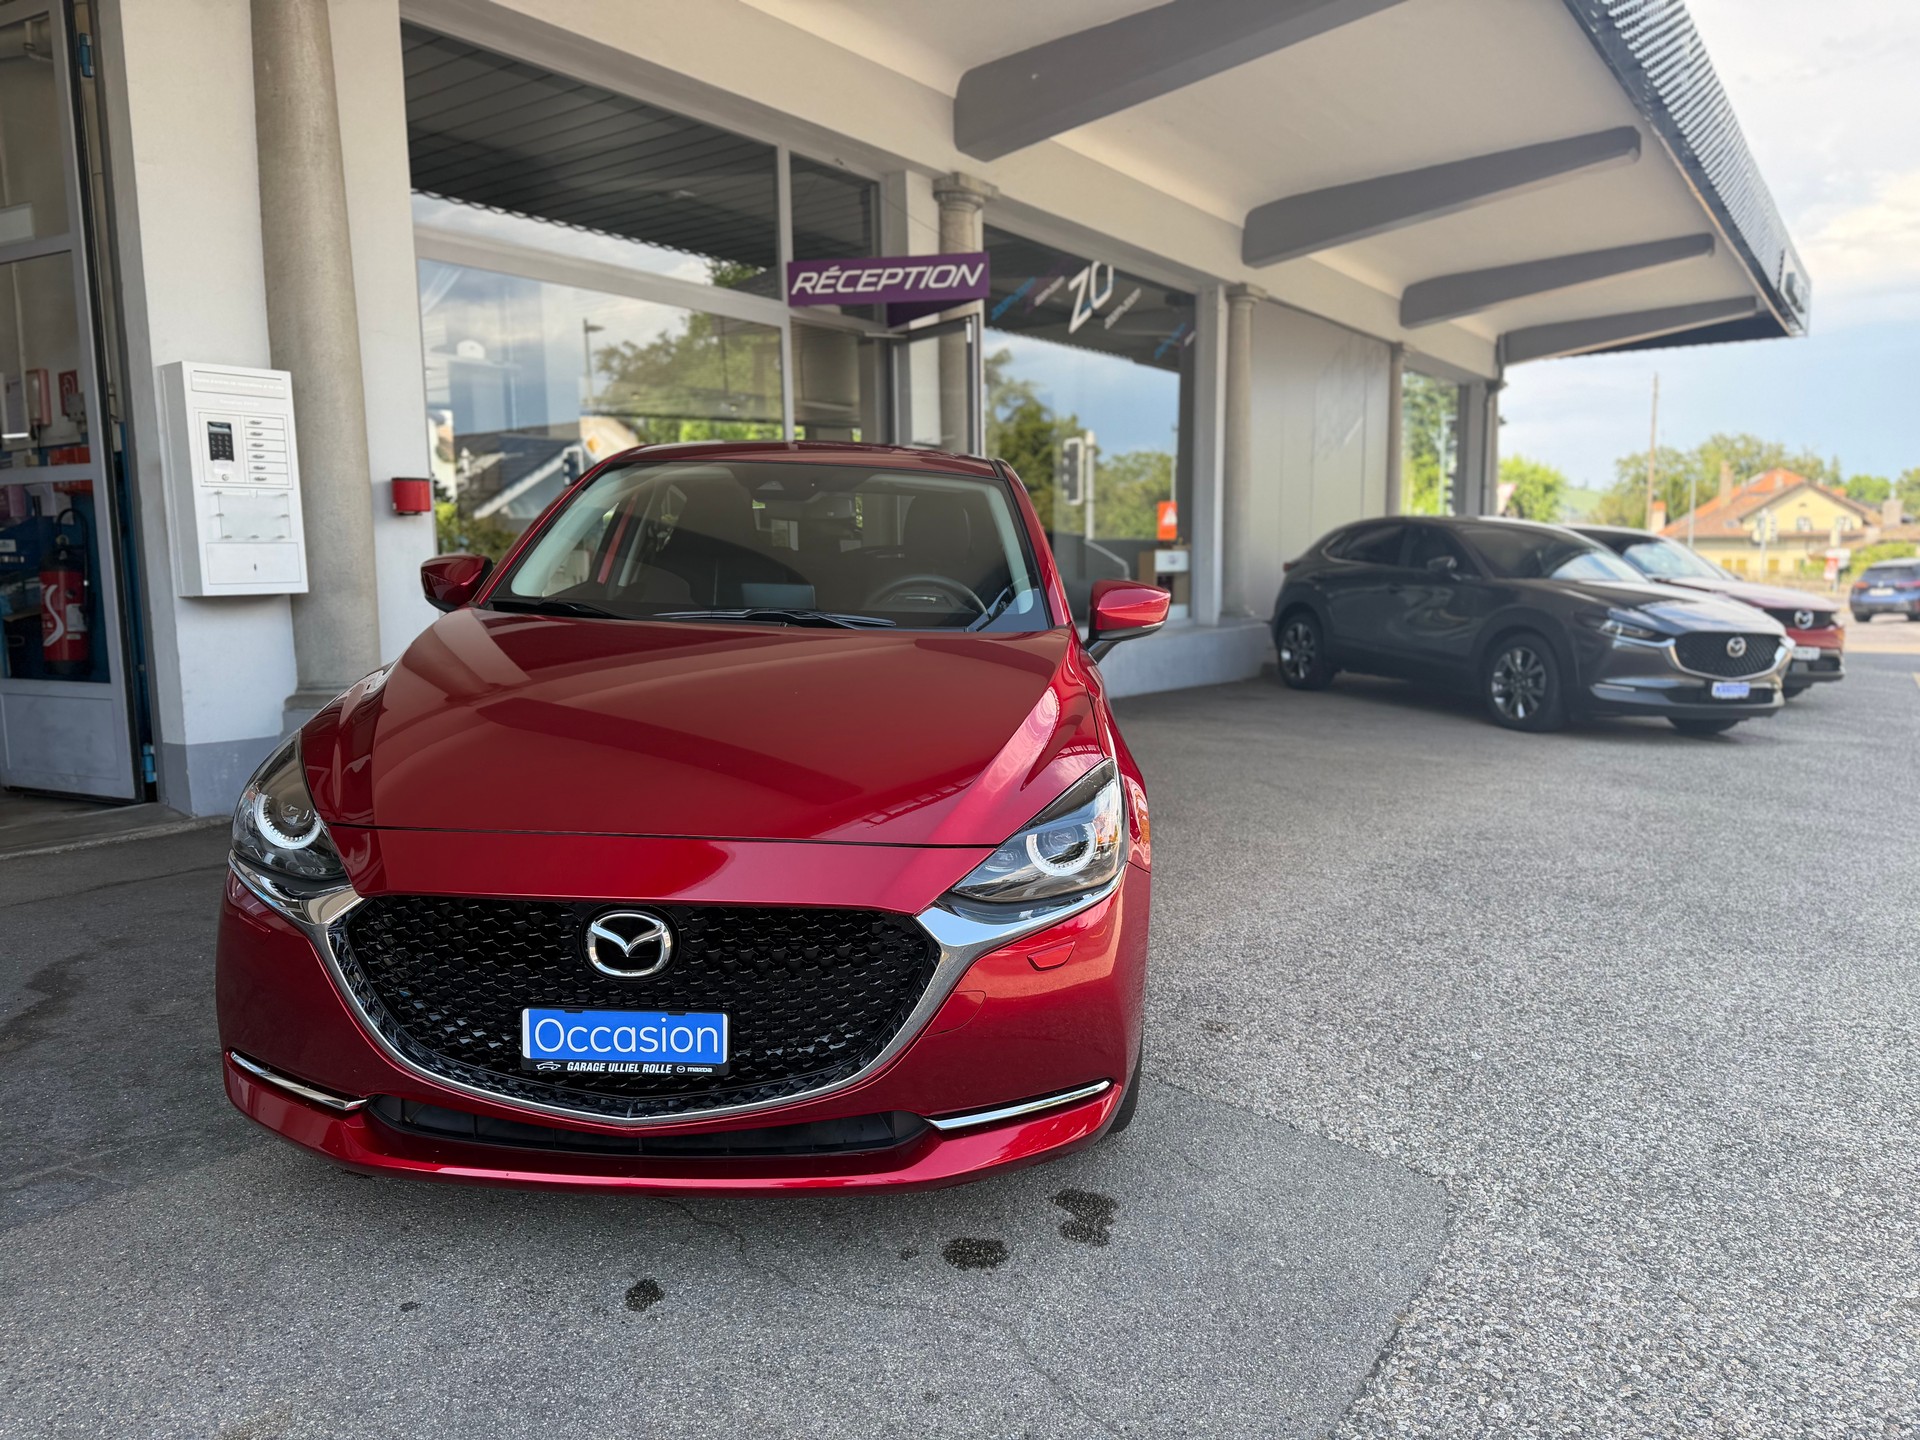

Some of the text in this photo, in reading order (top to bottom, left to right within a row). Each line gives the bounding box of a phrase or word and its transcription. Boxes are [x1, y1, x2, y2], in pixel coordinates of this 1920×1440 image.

[790, 262, 985, 296] RÉCEPTION
[534, 1017, 718, 1053] Occasion
[567, 1061, 606, 1072] GARAGE
[608, 1062, 640, 1073] ULLIEL
[642, 1063, 672, 1074] ROLLE
